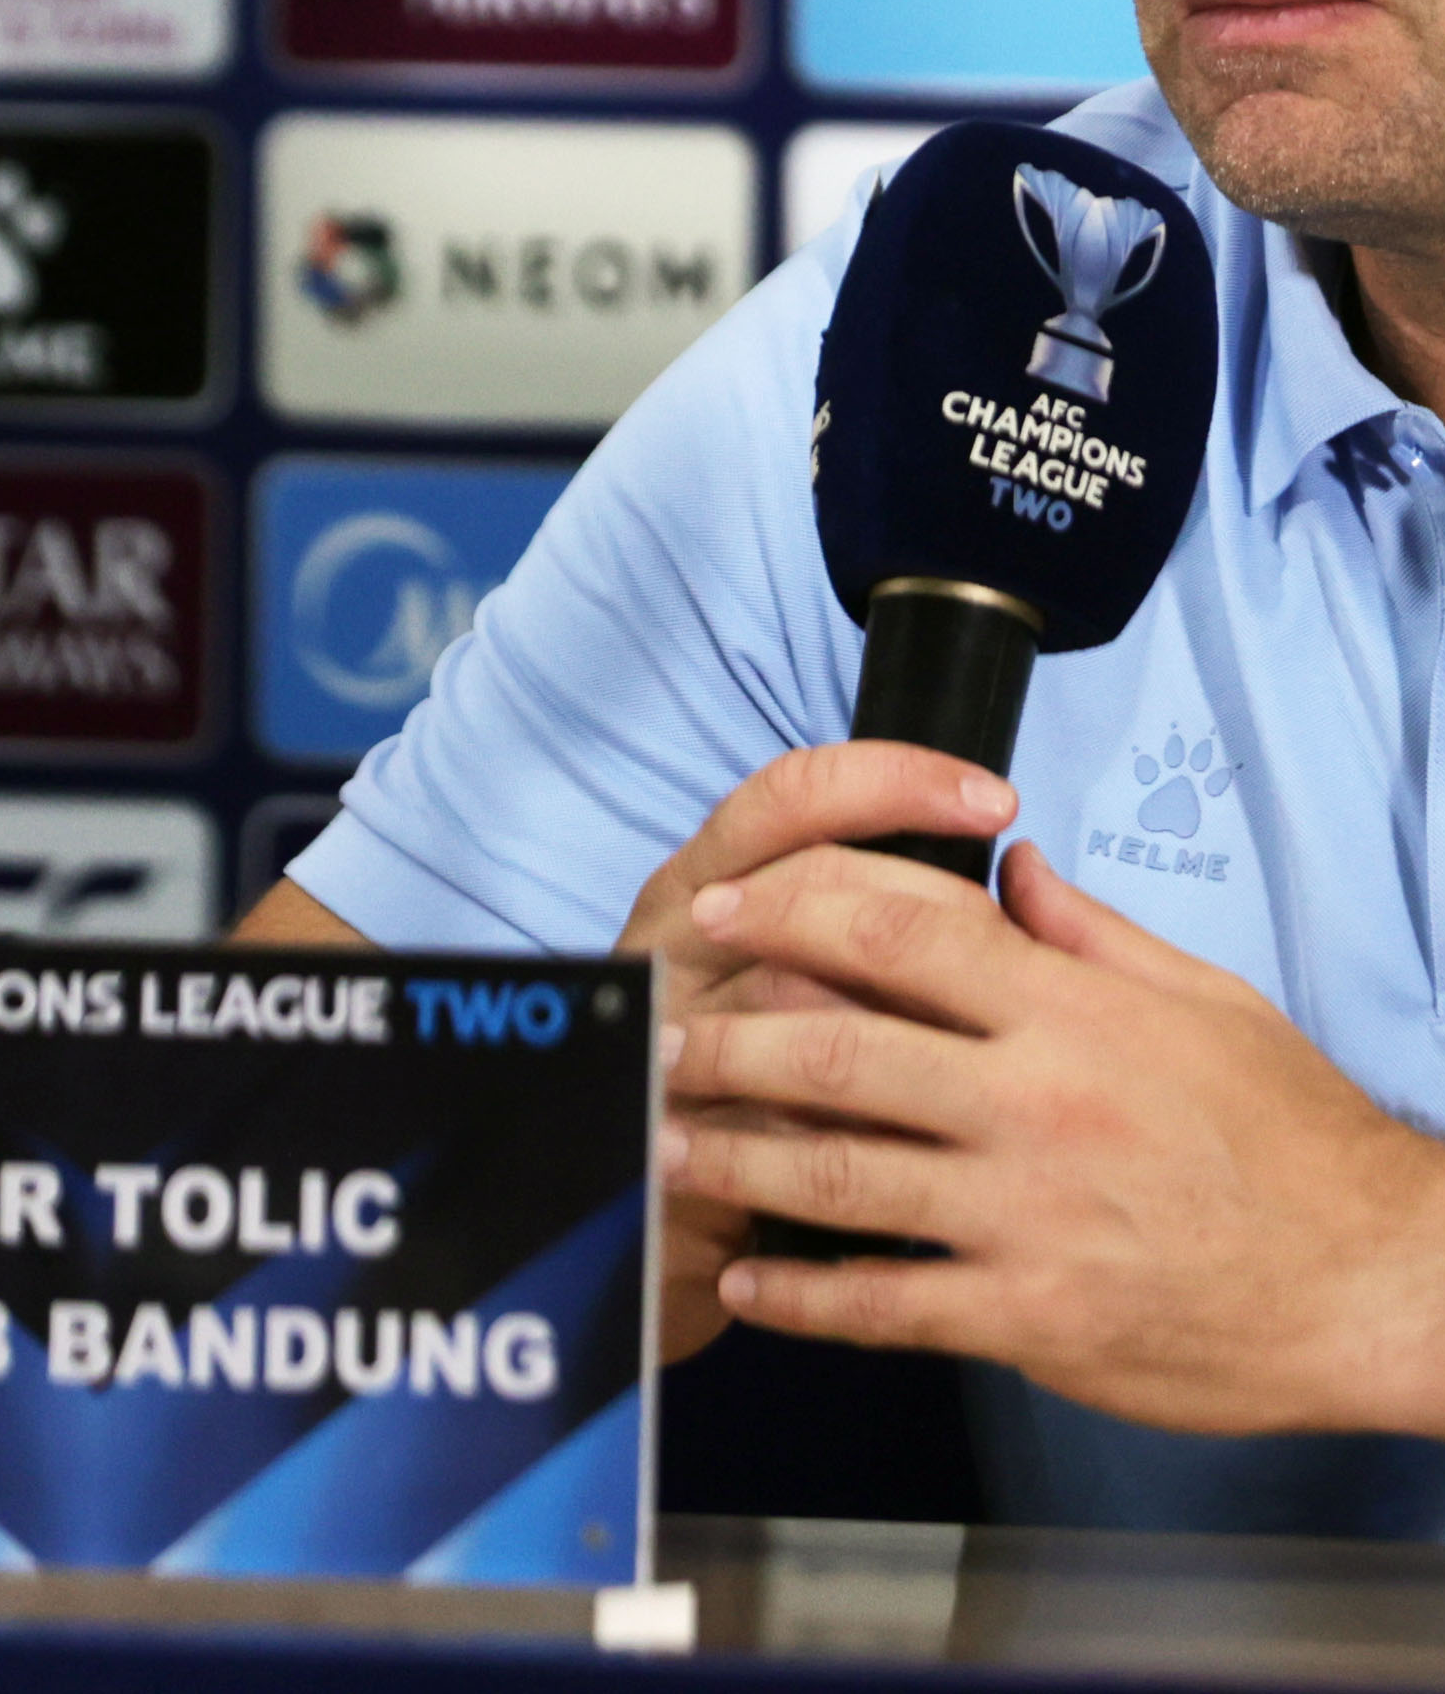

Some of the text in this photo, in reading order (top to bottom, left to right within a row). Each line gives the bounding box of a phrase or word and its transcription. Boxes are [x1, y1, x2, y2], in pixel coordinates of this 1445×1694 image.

[443, 234, 713, 307] NEOM
[942, 390, 1147, 489] CHAMPIONS
[1030, 393, 1086, 429] AFC
[969, 433, 1110, 509] LEAGUE
[989, 477, 1074, 532] TWO
[1088, 829, 1230, 881] KELME
[141, 972, 390, 1043] LEAGUE
[405, 978, 572, 1045] TWO
[95, 1165, 400, 1254] TOLIC
[47, 1303, 555, 1400] BANDUNG
